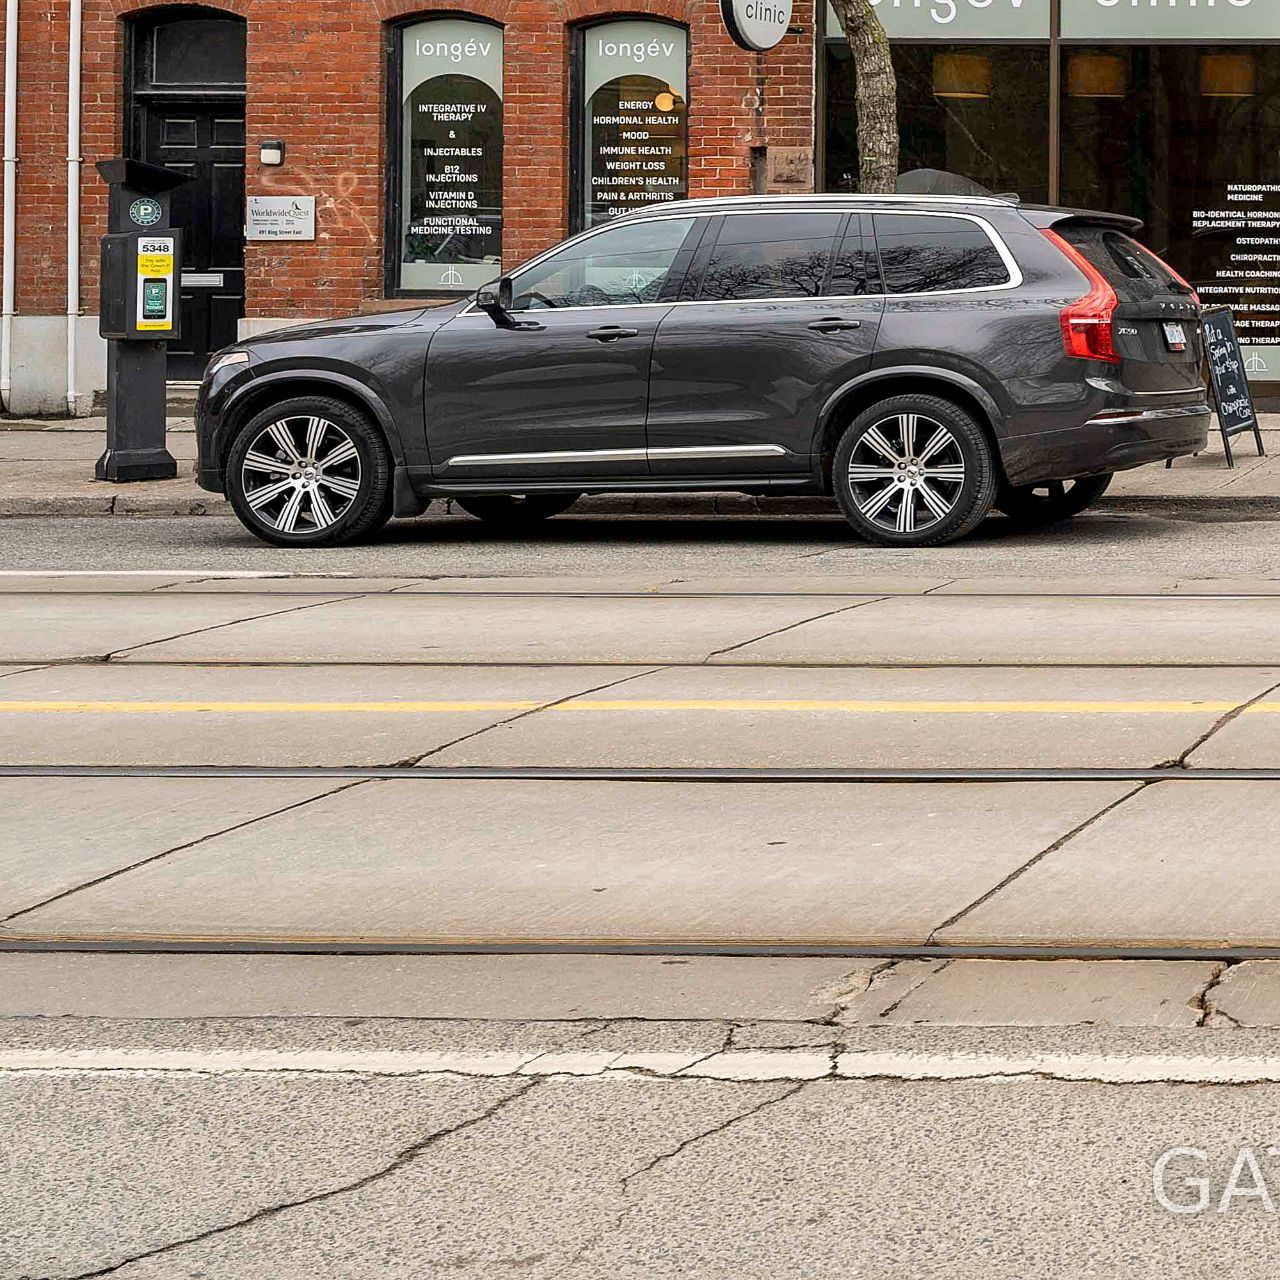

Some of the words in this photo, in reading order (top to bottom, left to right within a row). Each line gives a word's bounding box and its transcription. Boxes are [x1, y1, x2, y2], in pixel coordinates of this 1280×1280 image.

[745, 0, 786, 25] clinic
[415, 38, 492, 62] longév
[598, 38, 674, 62] longév
[418, 104, 476, 113] INTEGRATIVE
[477, 104, 487, 112] IV
[618, 100, 654, 110] ENERGY
[432, 113, 473, 122] THERAPY
[593, 116, 644, 124] HORMONAL
[646, 116, 679, 124] HEALTH
[449, 130, 456, 138] &
[622, 131, 649, 140] MOOD
[424, 148, 483, 156] INJECTABLES
[600, 146, 637, 155] IMMUNE
[638, 146, 672, 155] HEALTH
[444, 166, 460, 174] B12
[606, 162, 642, 170] WEIGHT
[642, 162, 666, 170] LOSS
[426, 174, 478, 182] INJECTIONS
[592, 176, 645, 185] CHILDREN'S
[646, 176, 680, 185] HEALTH
[429, 192, 467, 200] VITAMIN
[468, 192, 475, 200] D
[597, 192, 618, 200] PAIN
[619, 192, 627, 200] &
[628, 192, 674, 200] ARTHRITIS
[1227, 194, 1263, 202] MEDICINE
[426, 200, 478, 209] INJECTIONS
[608, 206, 627, 216] GUT
[1192, 210, 1246, 218] BIO-IDENTICAL
[424, 218, 480, 226] FUNCTIONAL
[411, 226, 454, 235] MEDICINE
[455, 226, 492, 235] TESTING
[142, 244, 170, 252] 5348
[1216, 270, 1244, 278] HEALTH
[1197, 286, 1244, 294] INTEGRATIVE
